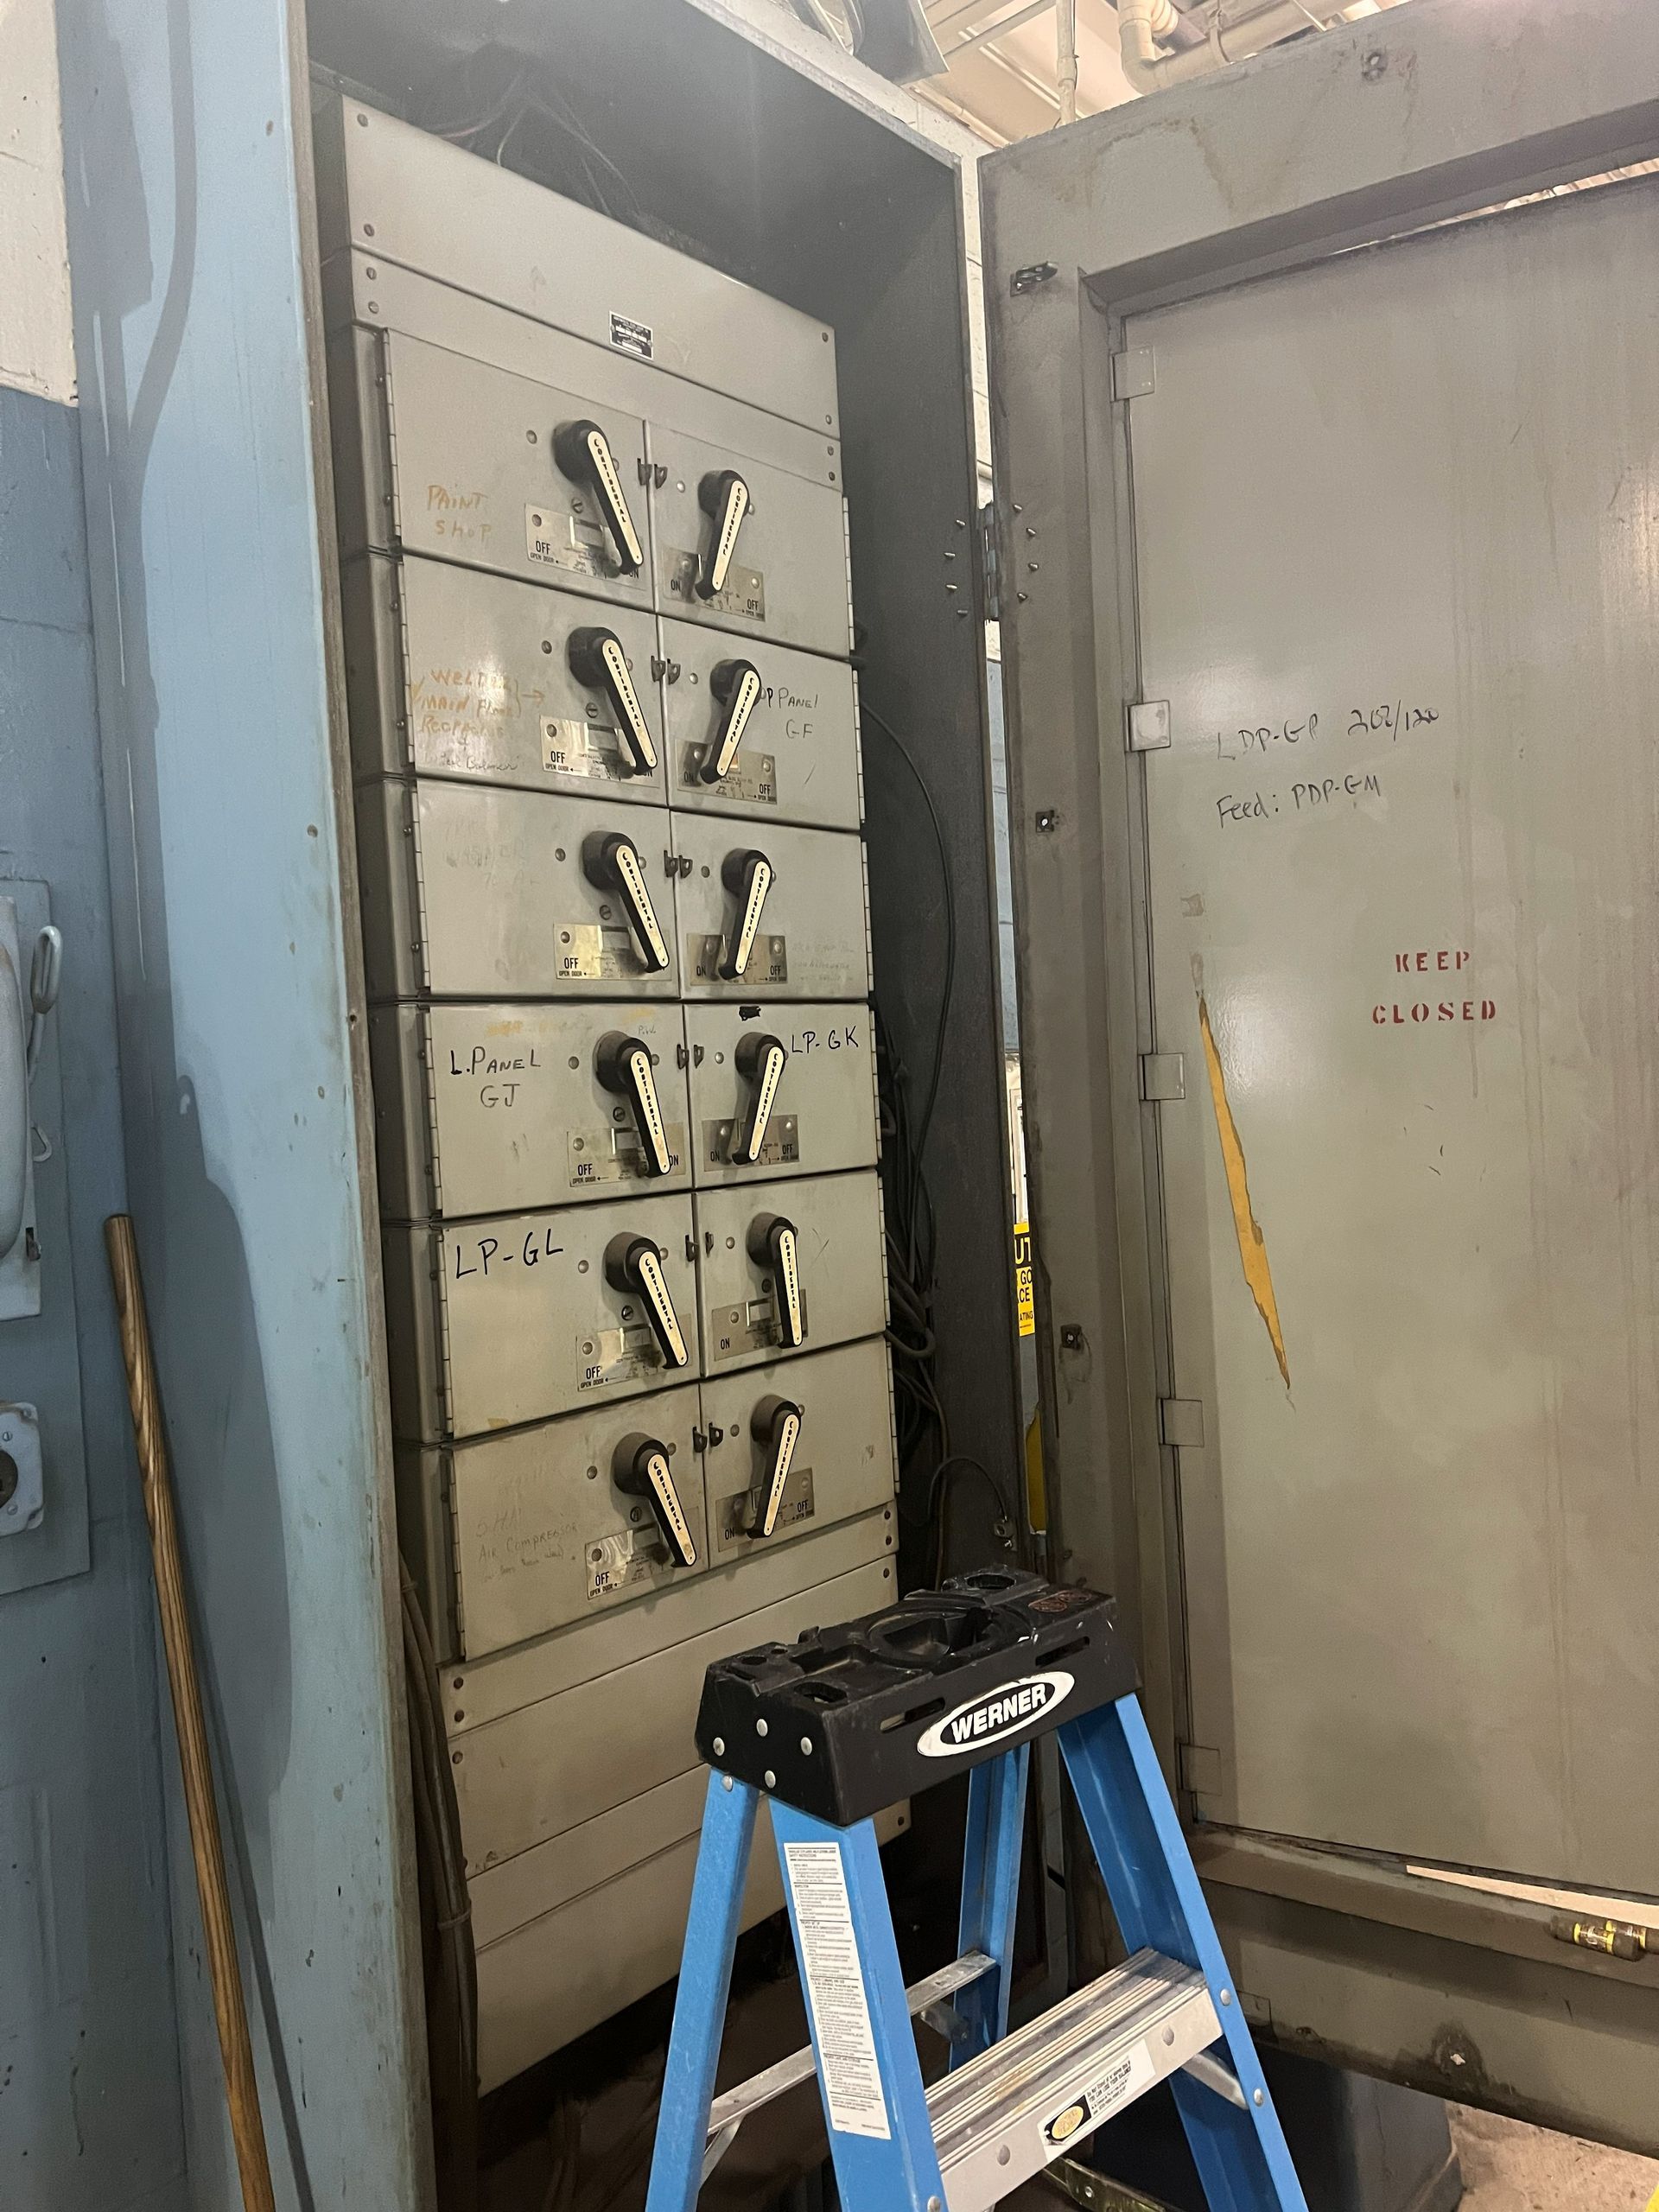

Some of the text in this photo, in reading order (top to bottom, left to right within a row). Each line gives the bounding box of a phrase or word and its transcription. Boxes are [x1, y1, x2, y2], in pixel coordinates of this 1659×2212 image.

[536, 540, 551, 555] OFF
[671, 580, 681, 592] ON
[747, 599, 760, 611] OFF
[550, 751, 566, 764] OFF
[759, 784, 772, 796] OFF
[1216, 791, 1280, 829] Feed:
[563, 957, 579, 969] OFF
[1395, 950, 1470, 973] KEEP
[696, 965, 706, 976] ON
[770, 965, 782, 976] OFF
[1372, 1000, 1497, 1025] CLOSED
[480, 1084, 520, 1109] GJ
[709, 1150, 721, 1161] ON
[782, 1143, 794, 1155] OFF
[577, 1163, 593, 1176] OFF
[455, 1228, 564, 1279] LP-GL
[1019, 1287, 1031, 1303] CE
[720, 1338, 730, 1350] ON
[586, 1365, 601, 1380] OFF
[797, 1499, 809, 1512] OFF
[724, 1529, 734, 1540] ON
[594, 1571, 610, 1587] OFF
[950, 1682, 1047, 1744] WERNER
